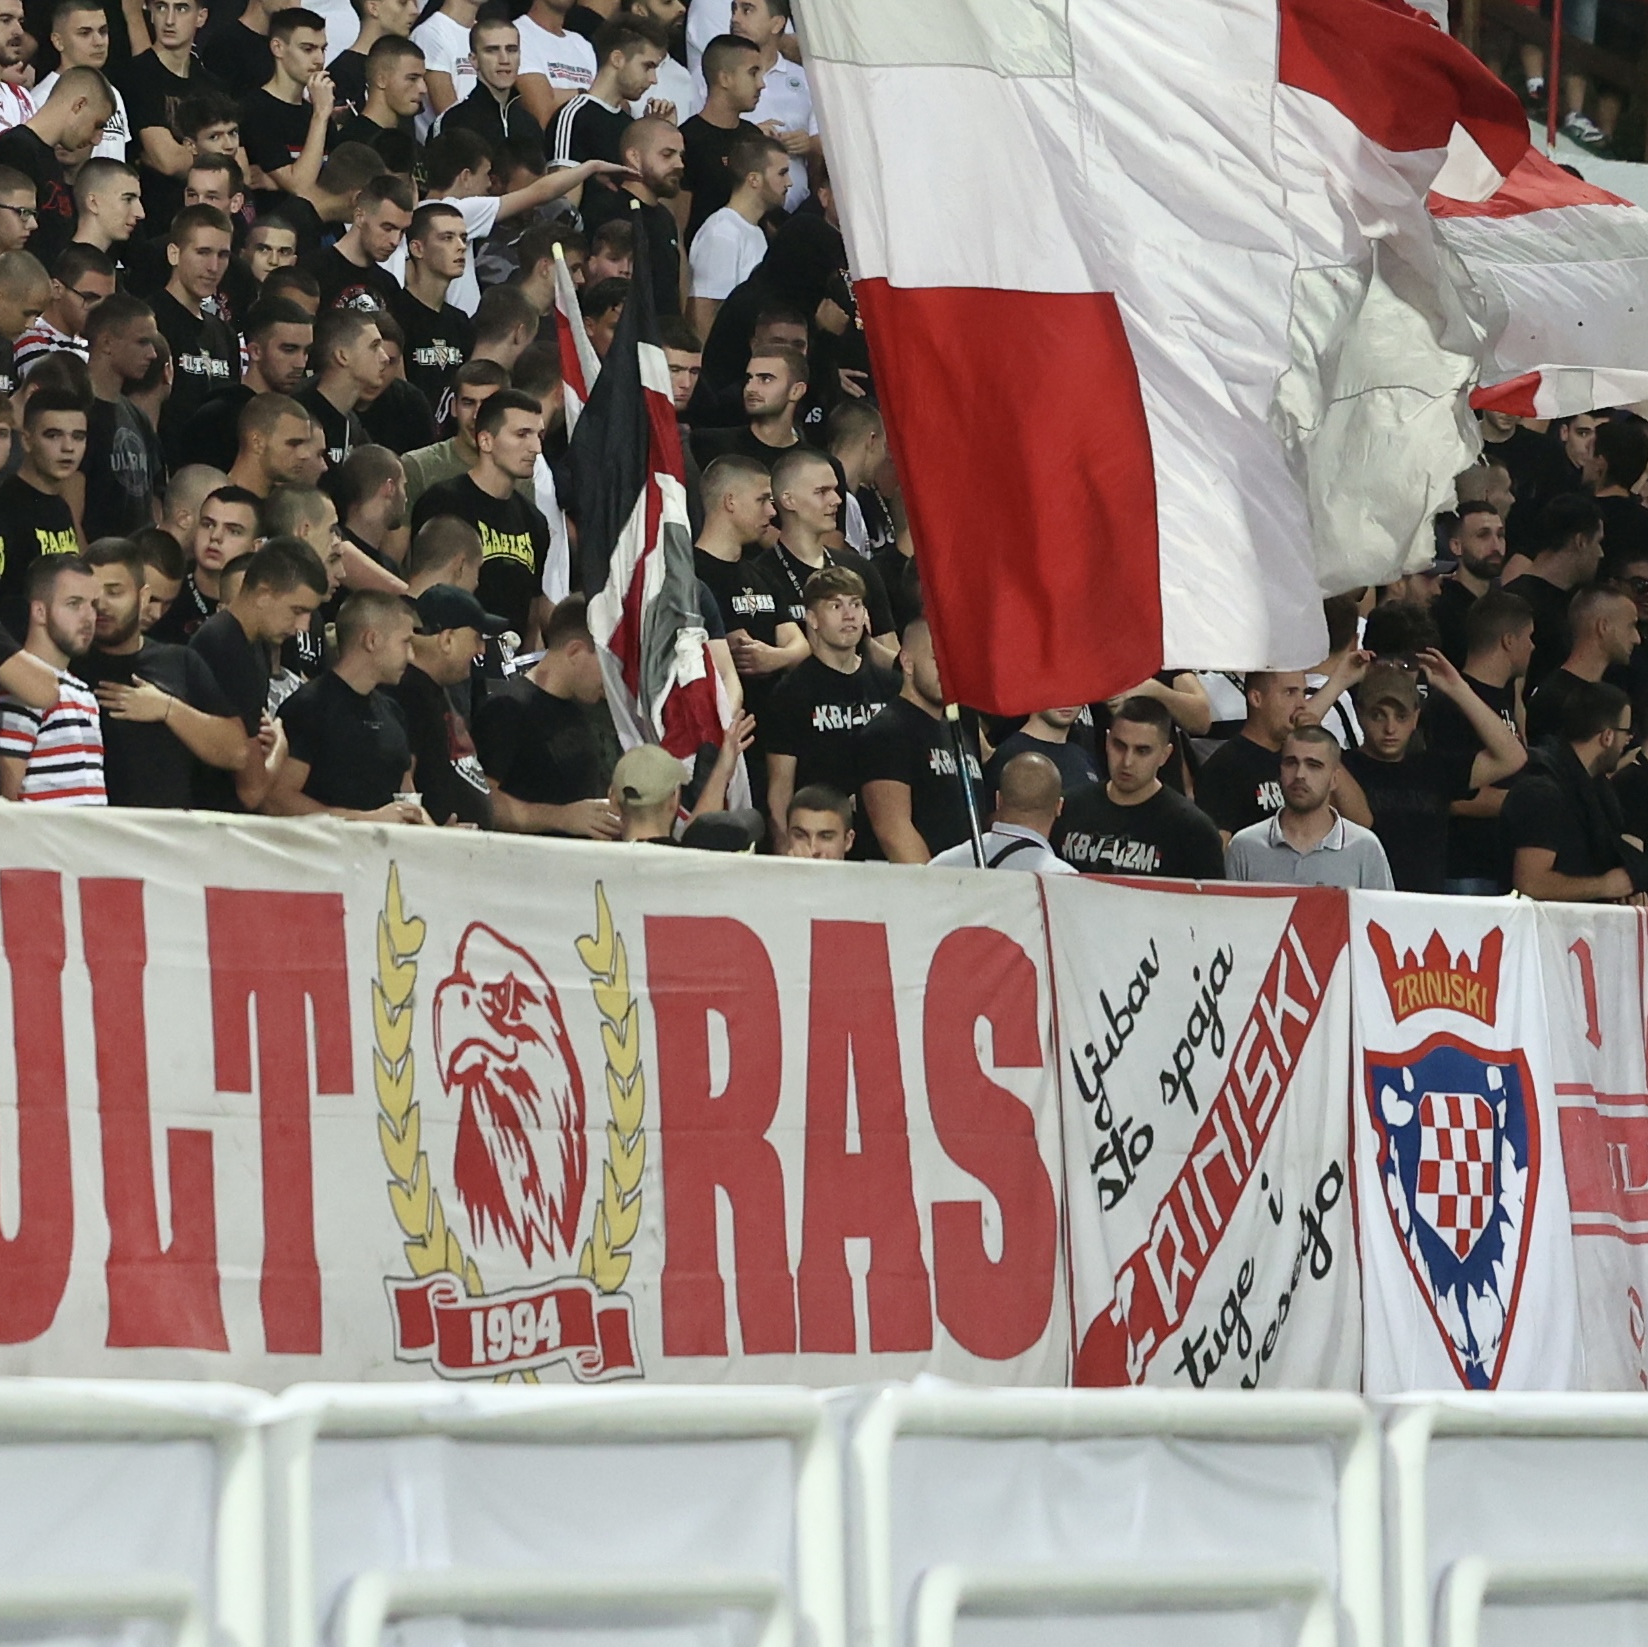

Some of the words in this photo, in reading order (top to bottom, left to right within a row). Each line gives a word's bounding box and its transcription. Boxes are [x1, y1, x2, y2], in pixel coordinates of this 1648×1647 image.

[478, 519, 535, 574] EAGLES
[1393, 970, 1488, 1021] ZRINJSKI
[470, 1295, 562, 1364] 1994
[1173, 1257, 1254, 1388] tuge
